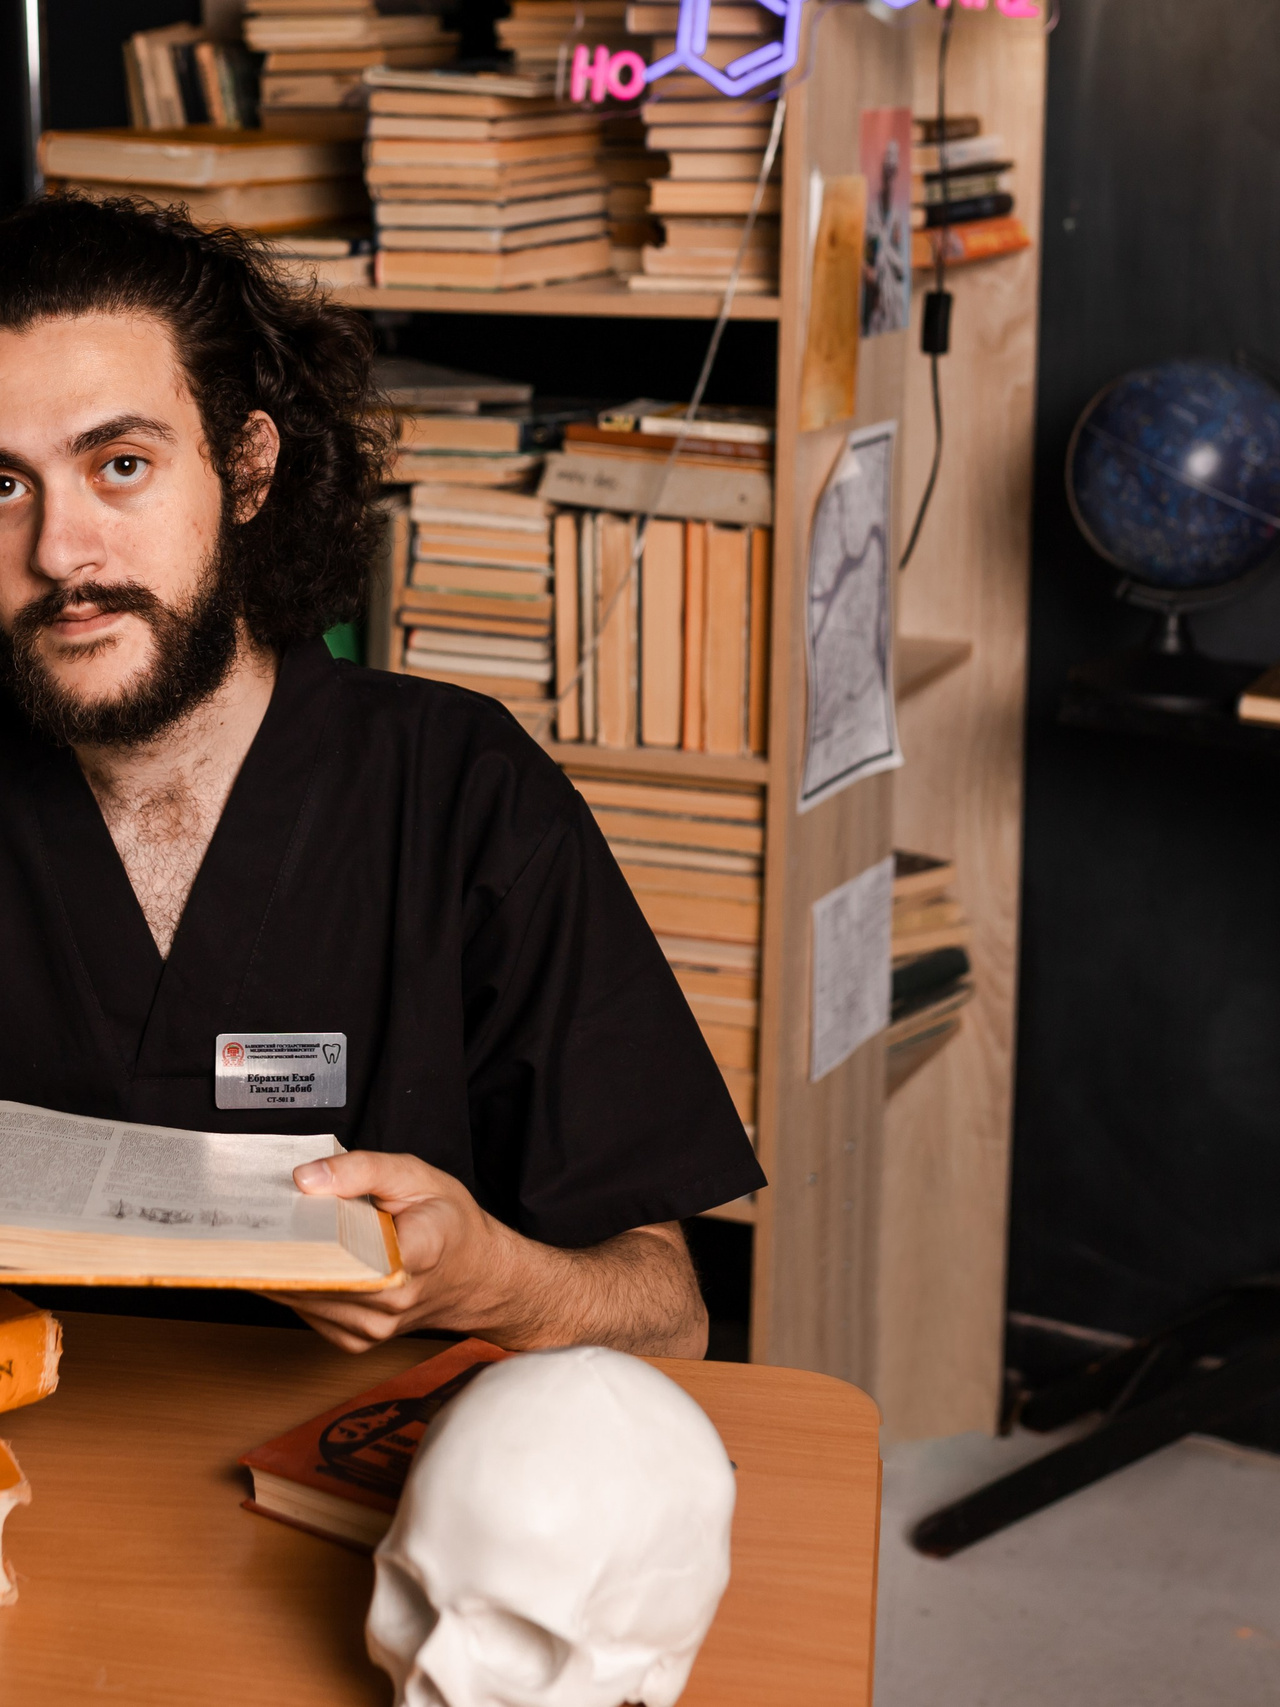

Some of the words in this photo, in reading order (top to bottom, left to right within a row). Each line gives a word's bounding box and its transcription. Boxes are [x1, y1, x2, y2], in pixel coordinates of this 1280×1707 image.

[570, 43, 647, 103] HO
[247, 1074, 289, 1084] Ебрахим
[292, 1073, 315, 1082] Ехаб
[249, 1085, 280, 1093] Гамал
[281, 1084, 313, 1093] Лабиб
